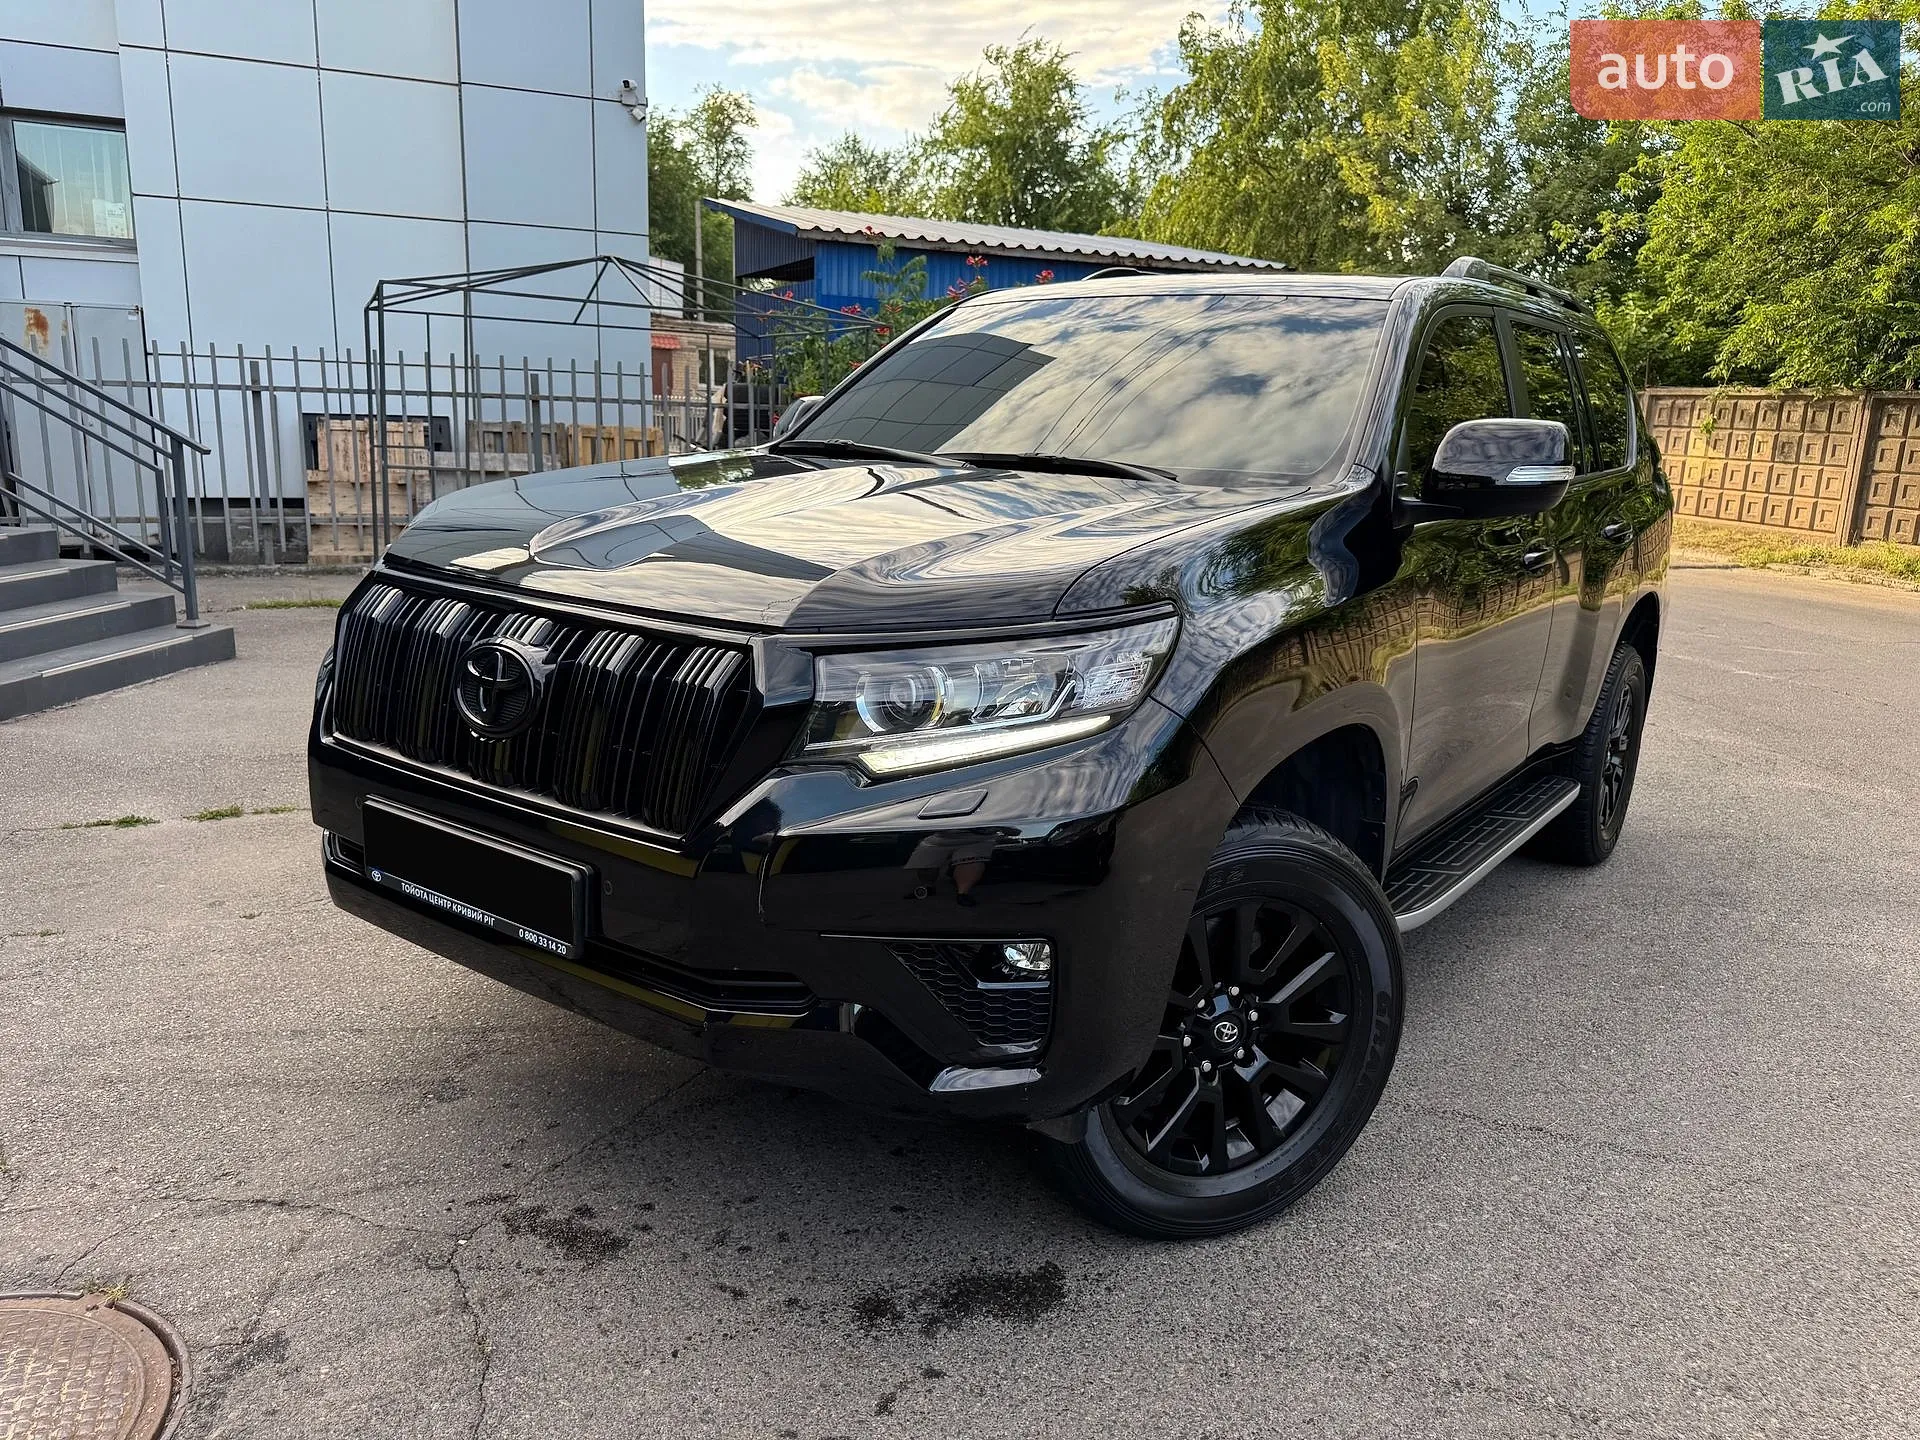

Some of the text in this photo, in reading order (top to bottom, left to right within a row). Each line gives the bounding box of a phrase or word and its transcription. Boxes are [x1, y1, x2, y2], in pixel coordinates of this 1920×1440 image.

[401, 882, 495, 926] ТОЙОТА ЦЕНТР КРИВИЙ РІГ
[519, 928, 567, 955] 0 800 33 14 20
